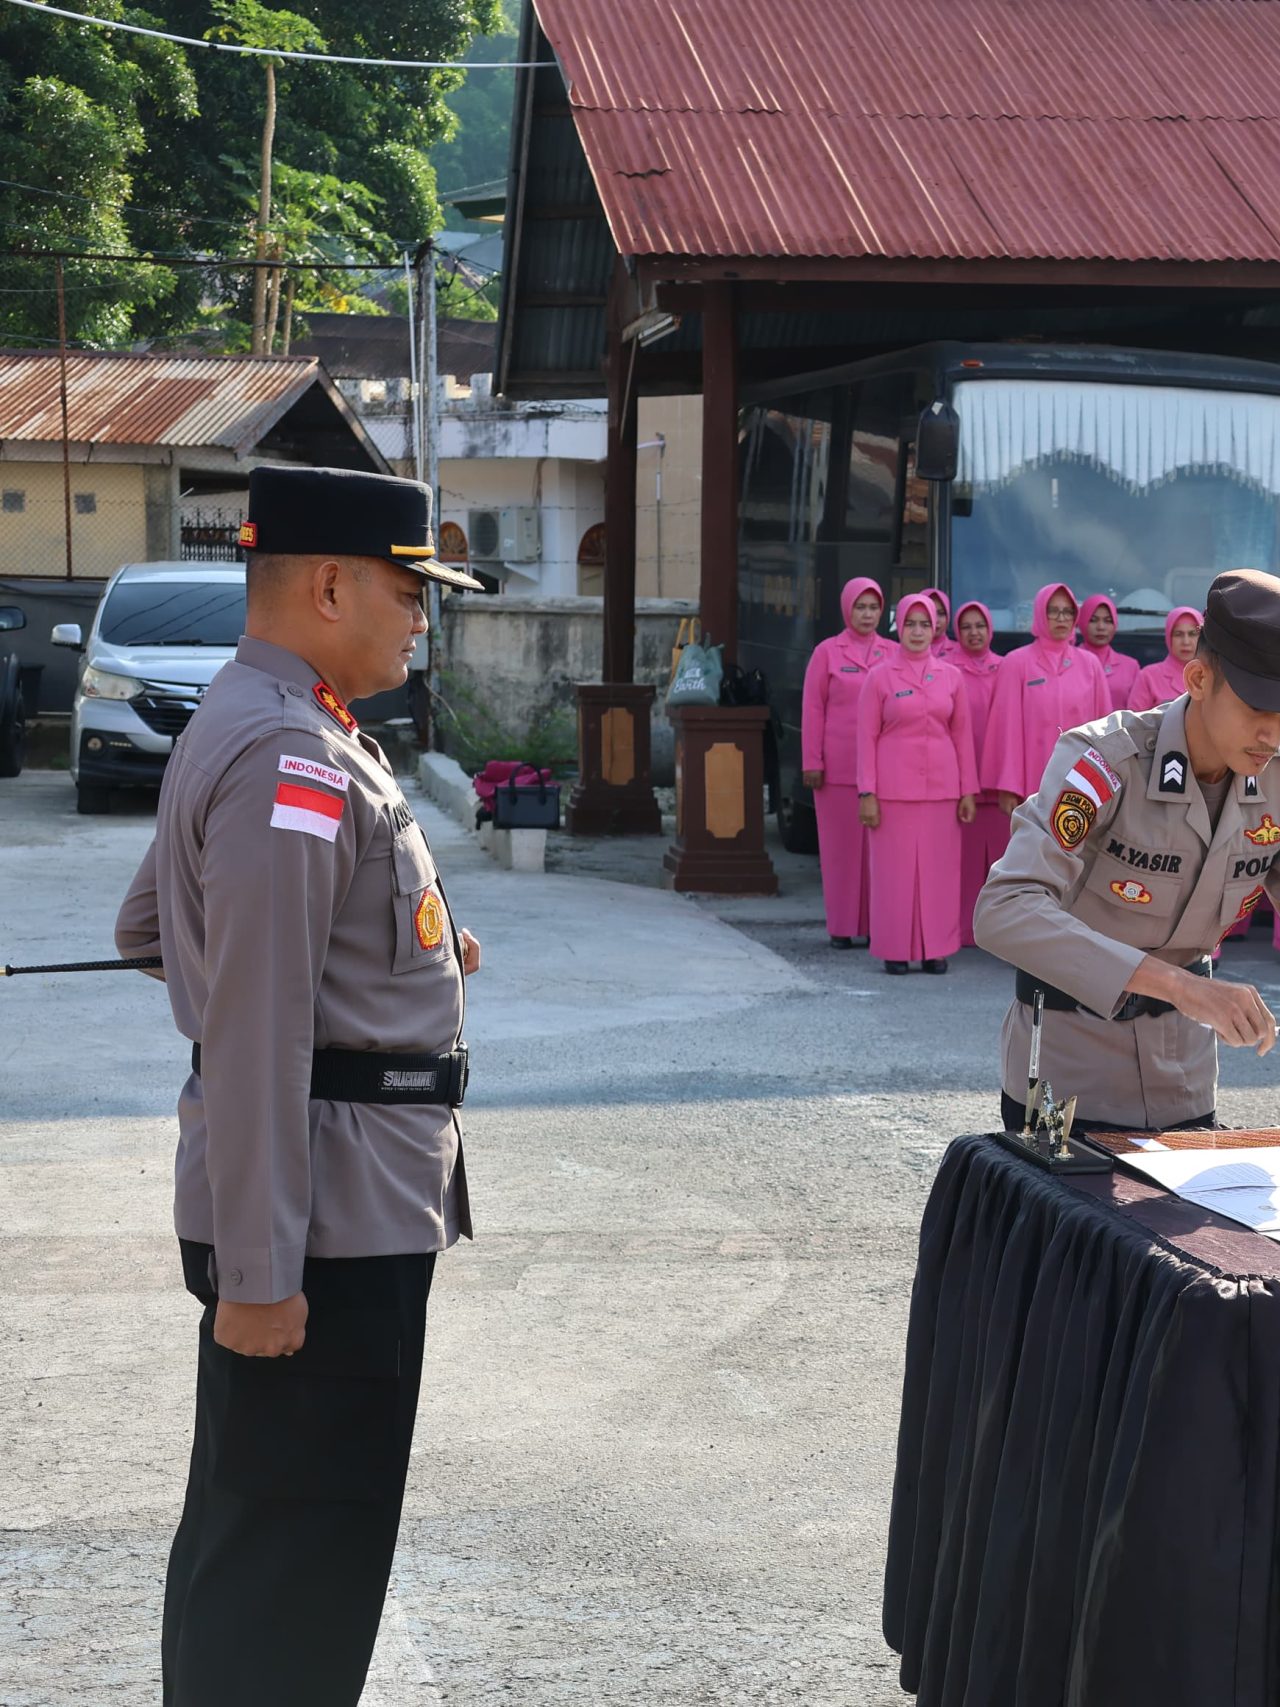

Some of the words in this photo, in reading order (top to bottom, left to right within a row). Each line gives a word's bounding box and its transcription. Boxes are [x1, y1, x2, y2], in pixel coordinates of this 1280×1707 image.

[284, 759, 344, 786] INDONESIA
[1088, 749, 1118, 787] INDONESIA
[1106, 838, 1183, 873] M.YASIR
